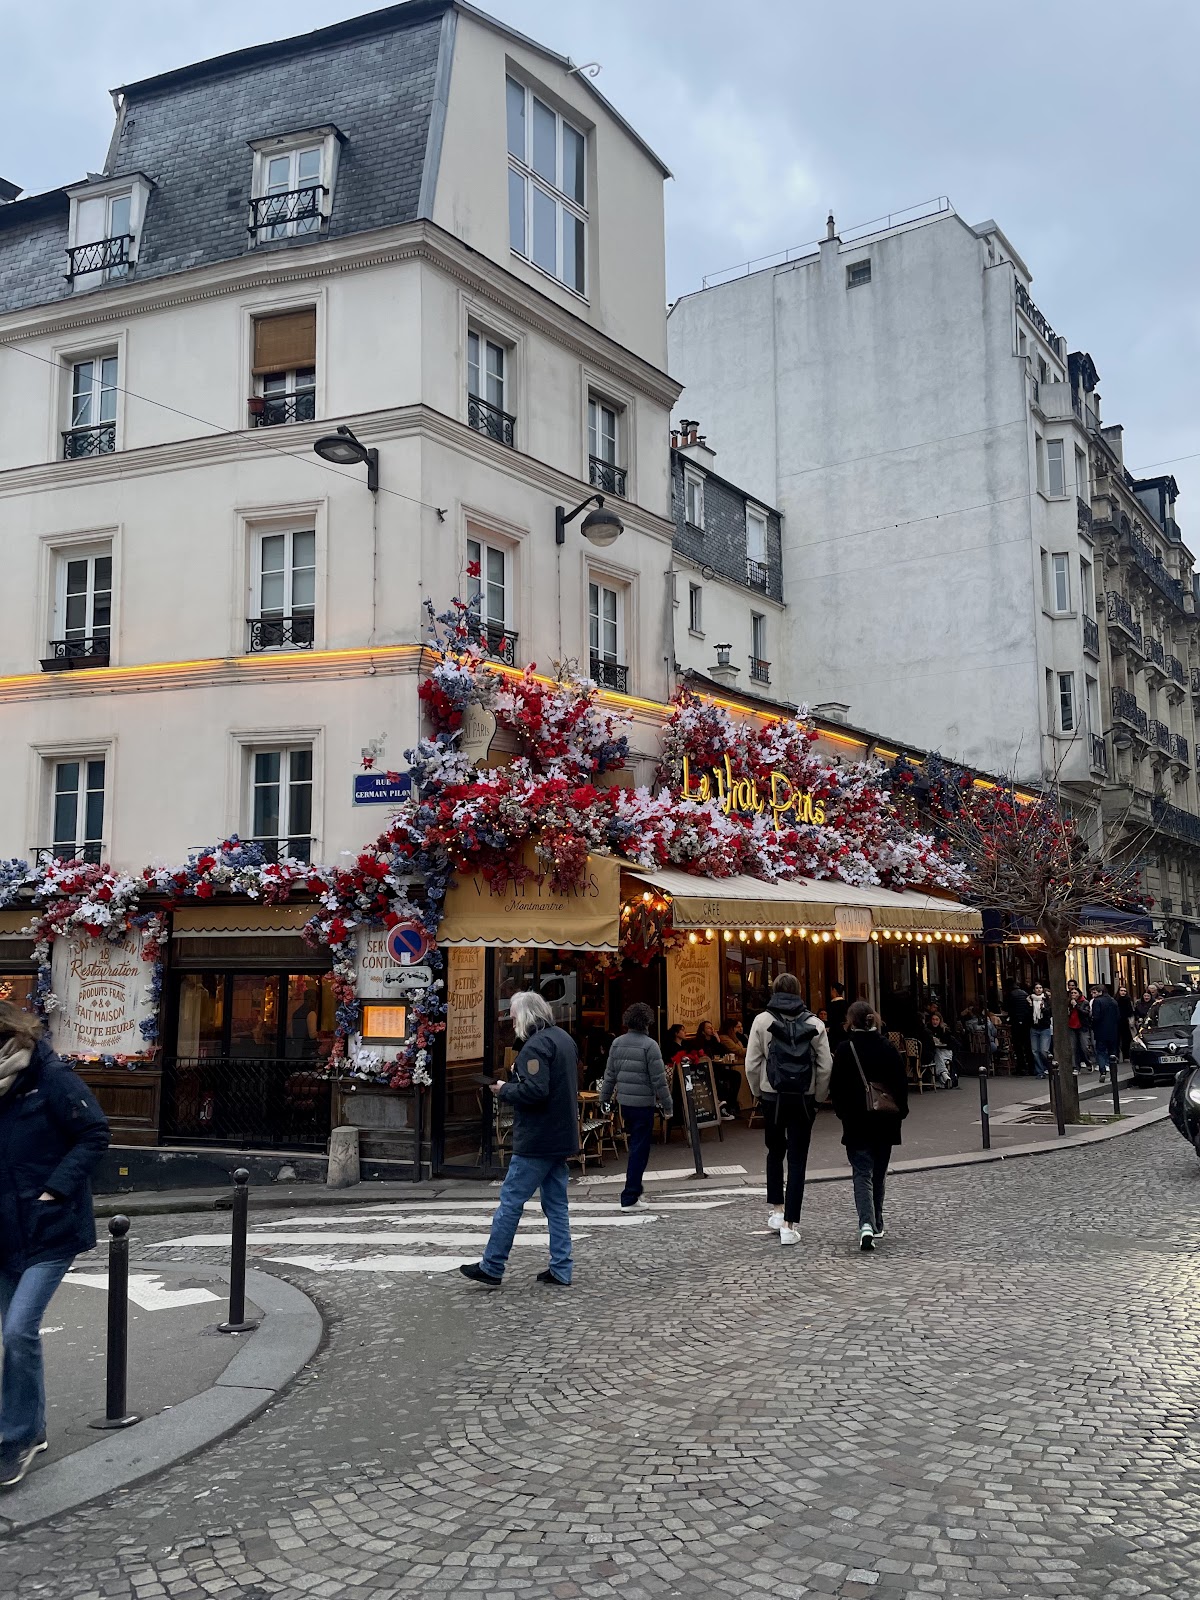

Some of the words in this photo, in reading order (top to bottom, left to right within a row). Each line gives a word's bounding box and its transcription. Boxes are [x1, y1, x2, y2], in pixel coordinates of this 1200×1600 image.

[472, 721, 490, 738] PARIS
[680, 754, 711, 803] Le
[713, 752, 765, 815] Vrai
[355, 790, 388, 799] GERMAIN
[389, 789, 412, 797] PILON
[504, 900, 565, 912] Montmartre
[99, 947, 110, 960] 18
[70, 959, 140, 980] Restauration
[454, 977, 477, 990] PETITS
[79, 986, 108, 1002] PRODUITS
[109, 987, 126, 1003] FRAIS
[98, 998, 104, 1008] &
[77, 1005, 93, 1021] FAIT
[94, 1005, 125, 1022] MAISON
[73, 1022, 104, 1036] TOUTE
[105, 1019, 135, 1036] HEURE
